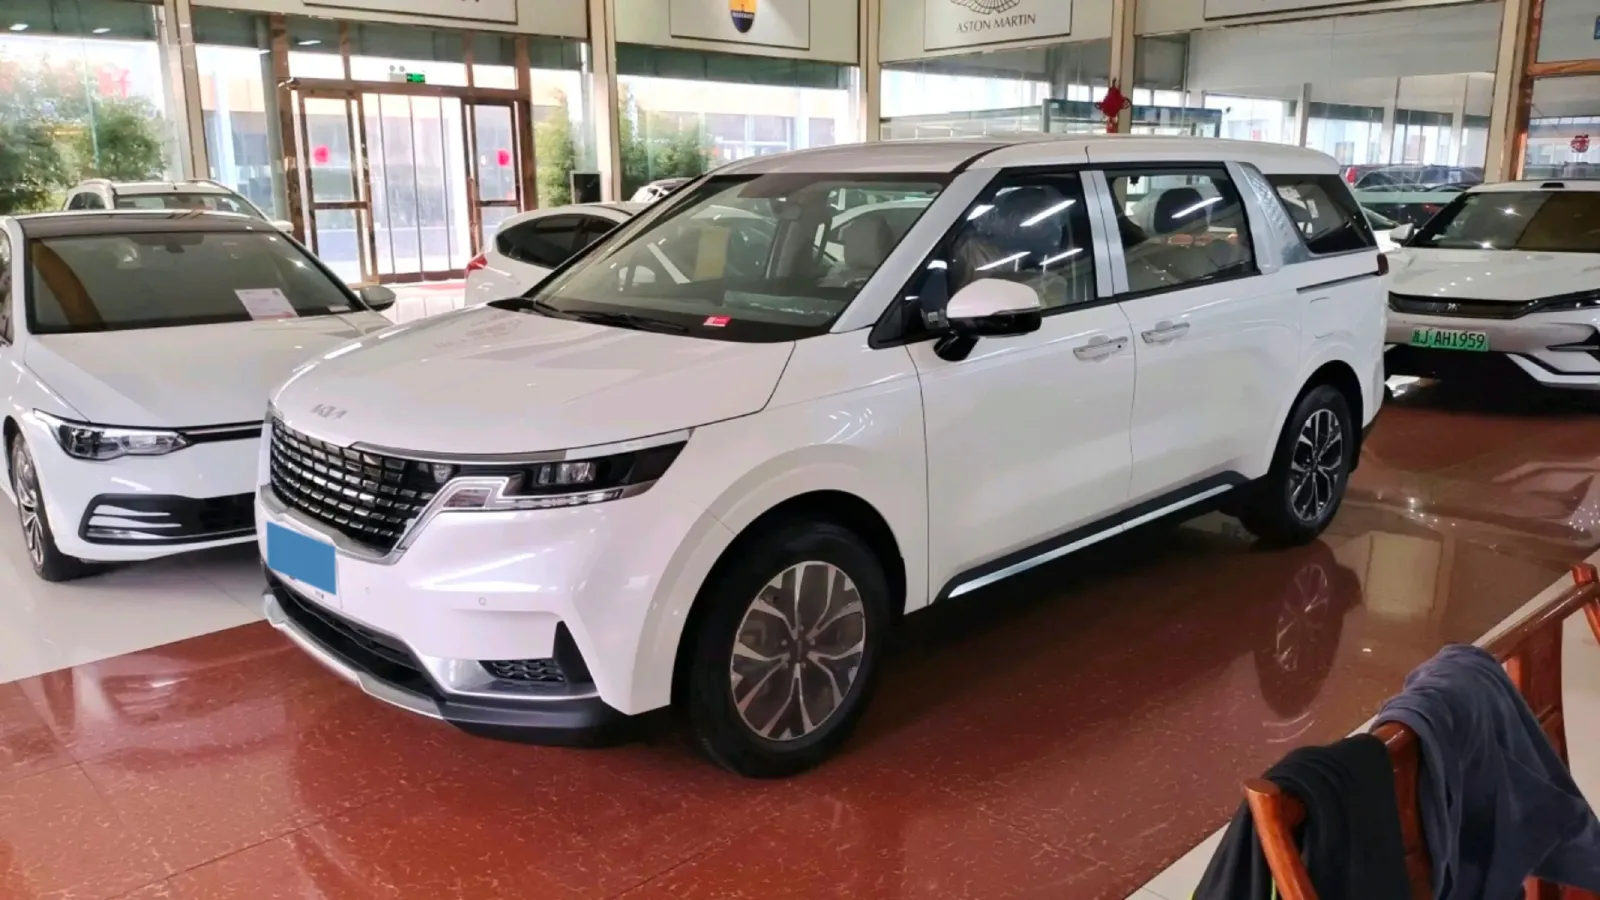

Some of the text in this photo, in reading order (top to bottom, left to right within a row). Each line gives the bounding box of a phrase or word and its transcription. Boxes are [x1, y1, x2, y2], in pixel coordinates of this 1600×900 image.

[957, 13, 1036, 33] ASTON MARTIN
[1434, 331, 1485, 349] AH1959
